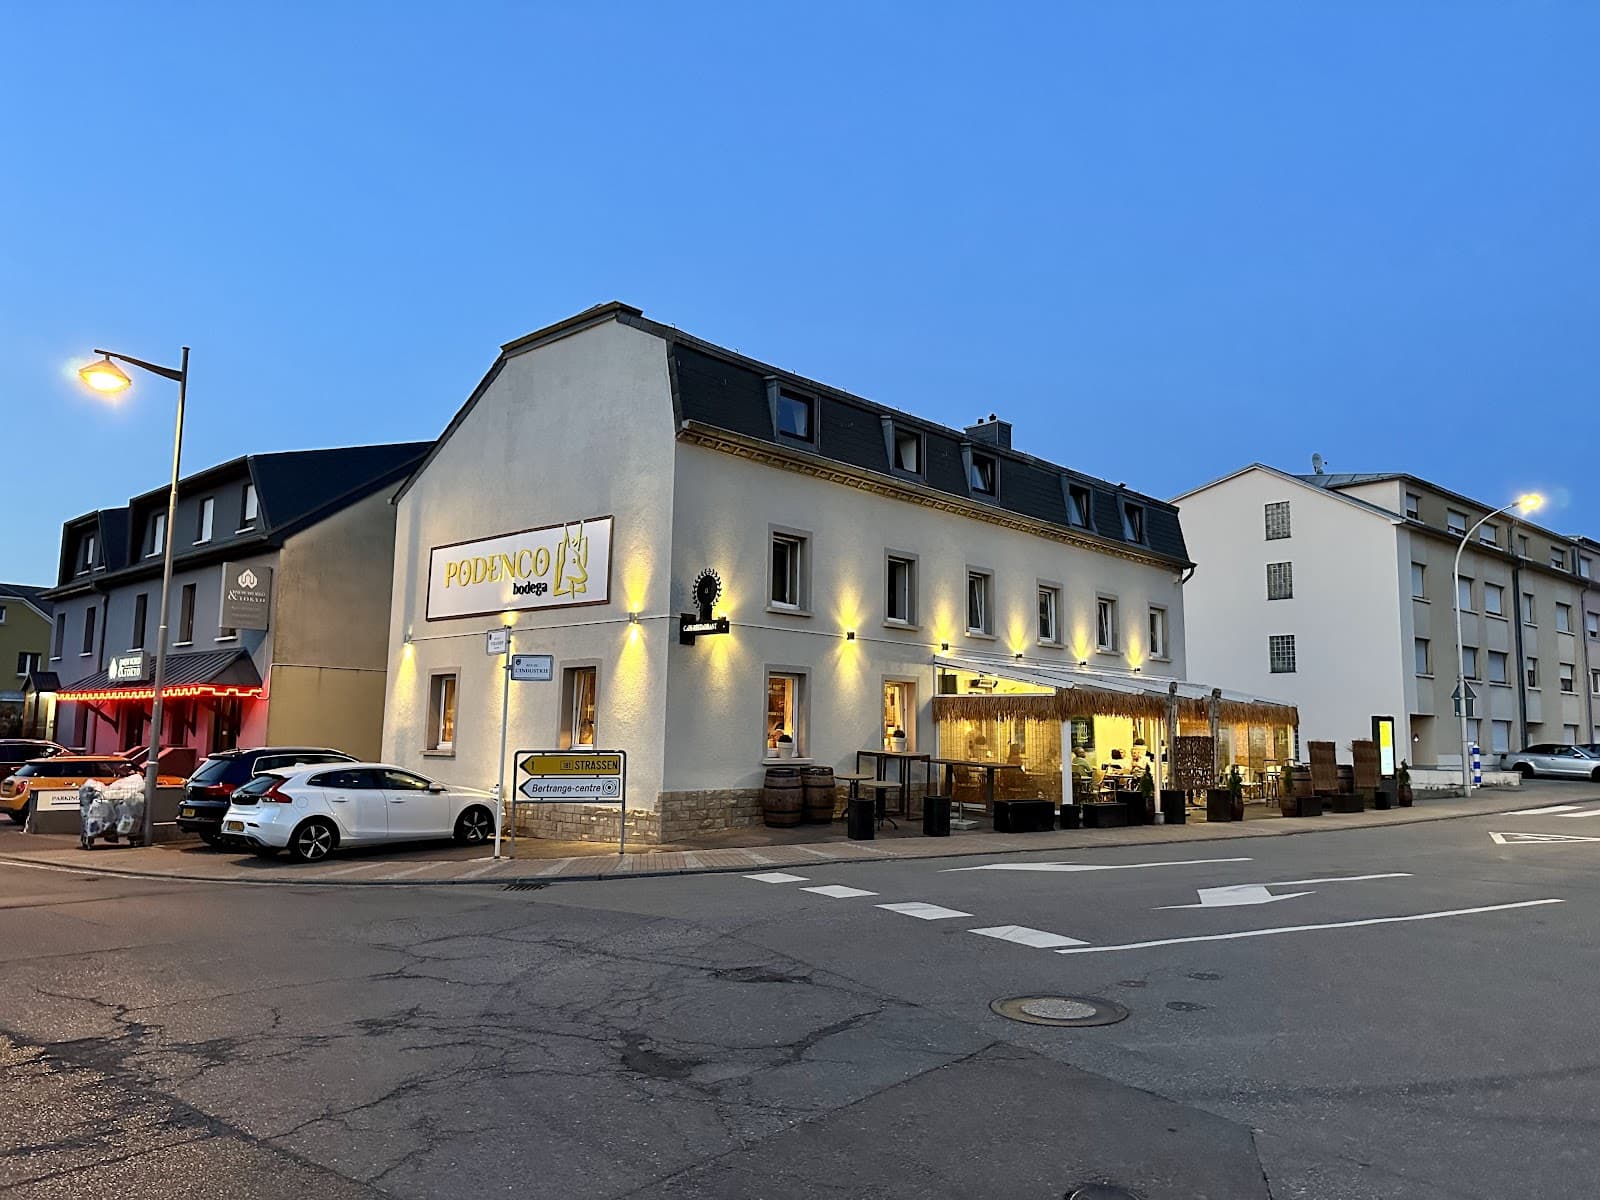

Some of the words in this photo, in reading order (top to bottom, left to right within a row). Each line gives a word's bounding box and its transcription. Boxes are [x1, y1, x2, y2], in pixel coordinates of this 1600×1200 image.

[445, 547, 550, 588] PODENCO
[513, 581, 548, 596] bodega
[574, 760, 618, 770] STRASSEN
[531, 783, 601, 795] Bertrange-centre
